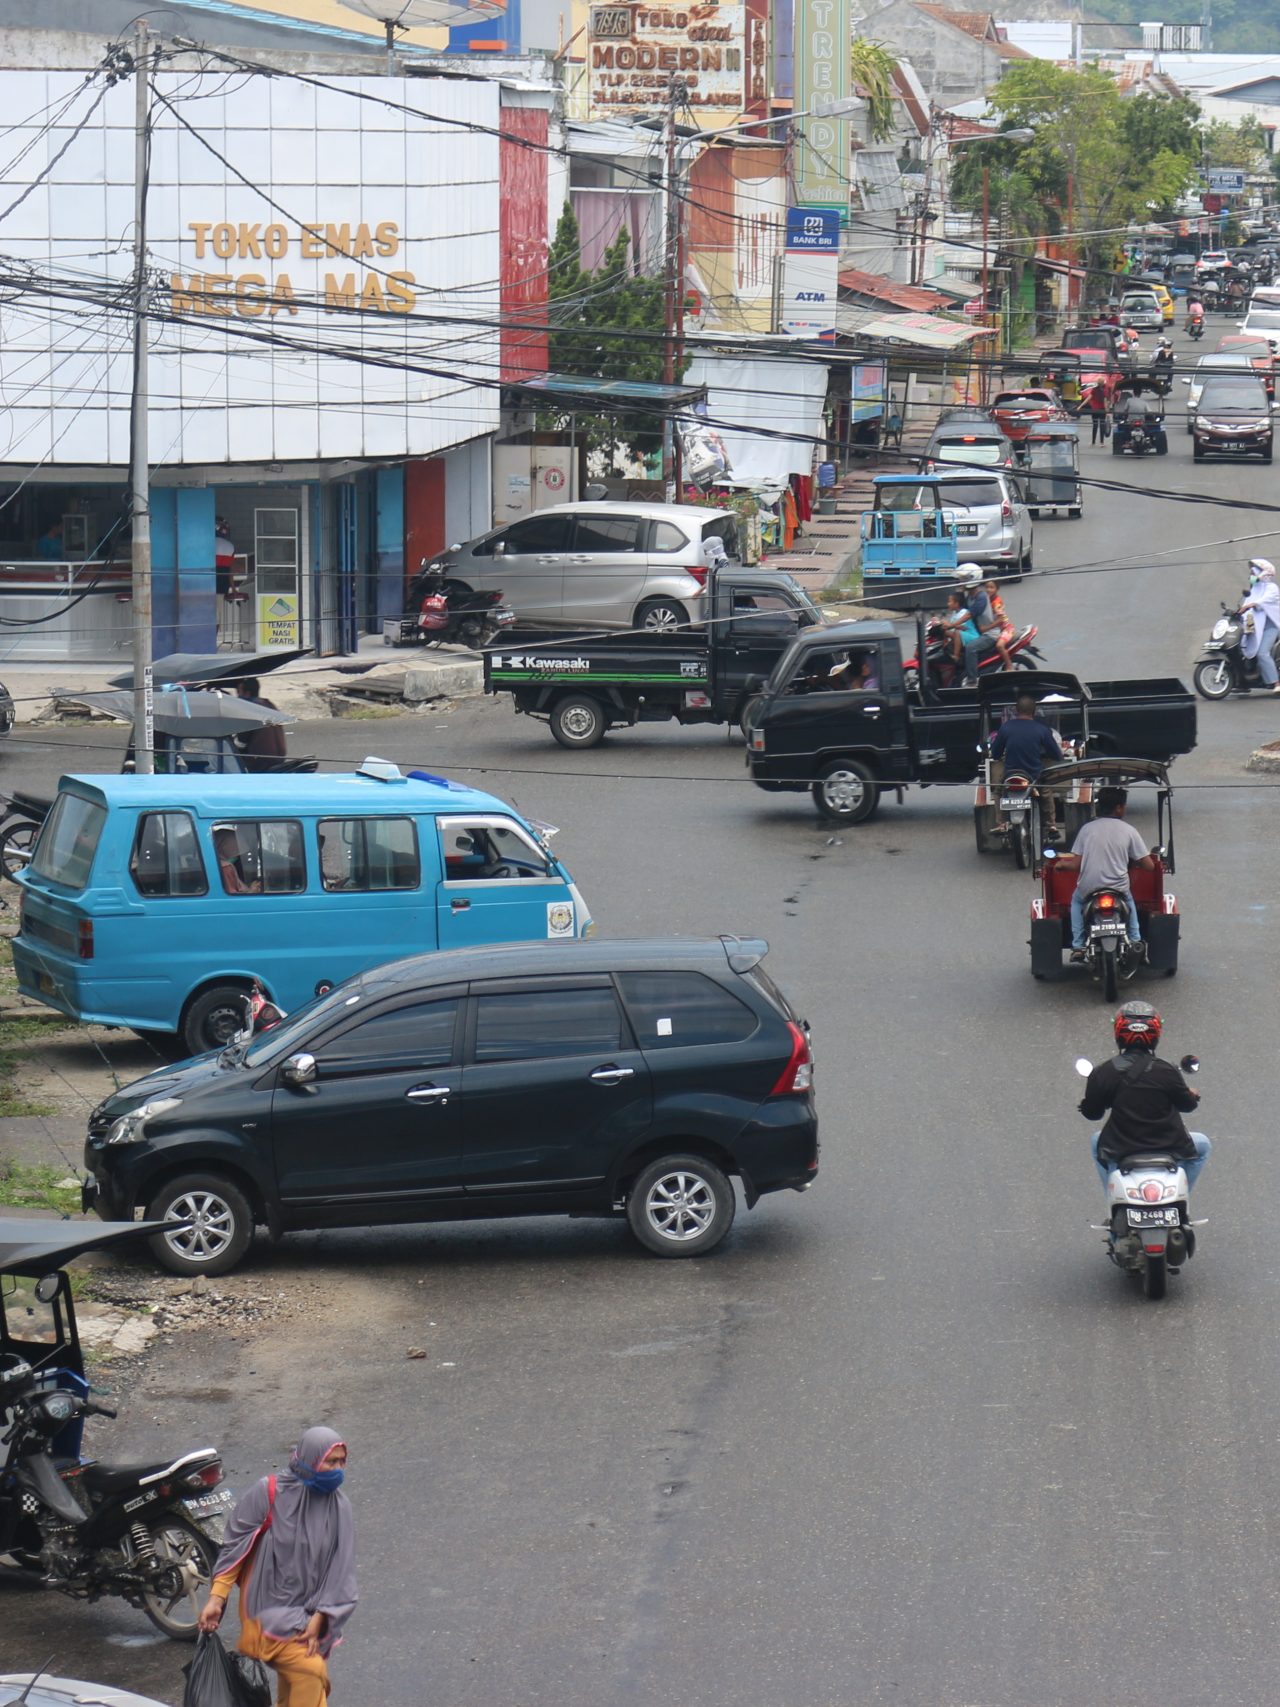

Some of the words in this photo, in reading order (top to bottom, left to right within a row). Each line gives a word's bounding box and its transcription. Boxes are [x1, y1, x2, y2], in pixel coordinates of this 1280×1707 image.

[637, 11, 688, 28] TOKO
[592, 46, 722, 71] MODERN
[188, 222, 289, 259] TOKO
[301, 222, 399, 258] EMAS
[793, 236, 817, 245] BANK
[170, 273, 299, 317] MEGA
[323, 271, 417, 315] MAS
[795, 291, 825, 303] ATM
[268, 621, 296, 629] TEMPAT
[268, 637, 295, 645] GRATIS
[525, 656, 590, 669] Kawasaki
[1130, 1210, 1142, 1220] DM
[1142, 1210, 1164, 1219] 2468
